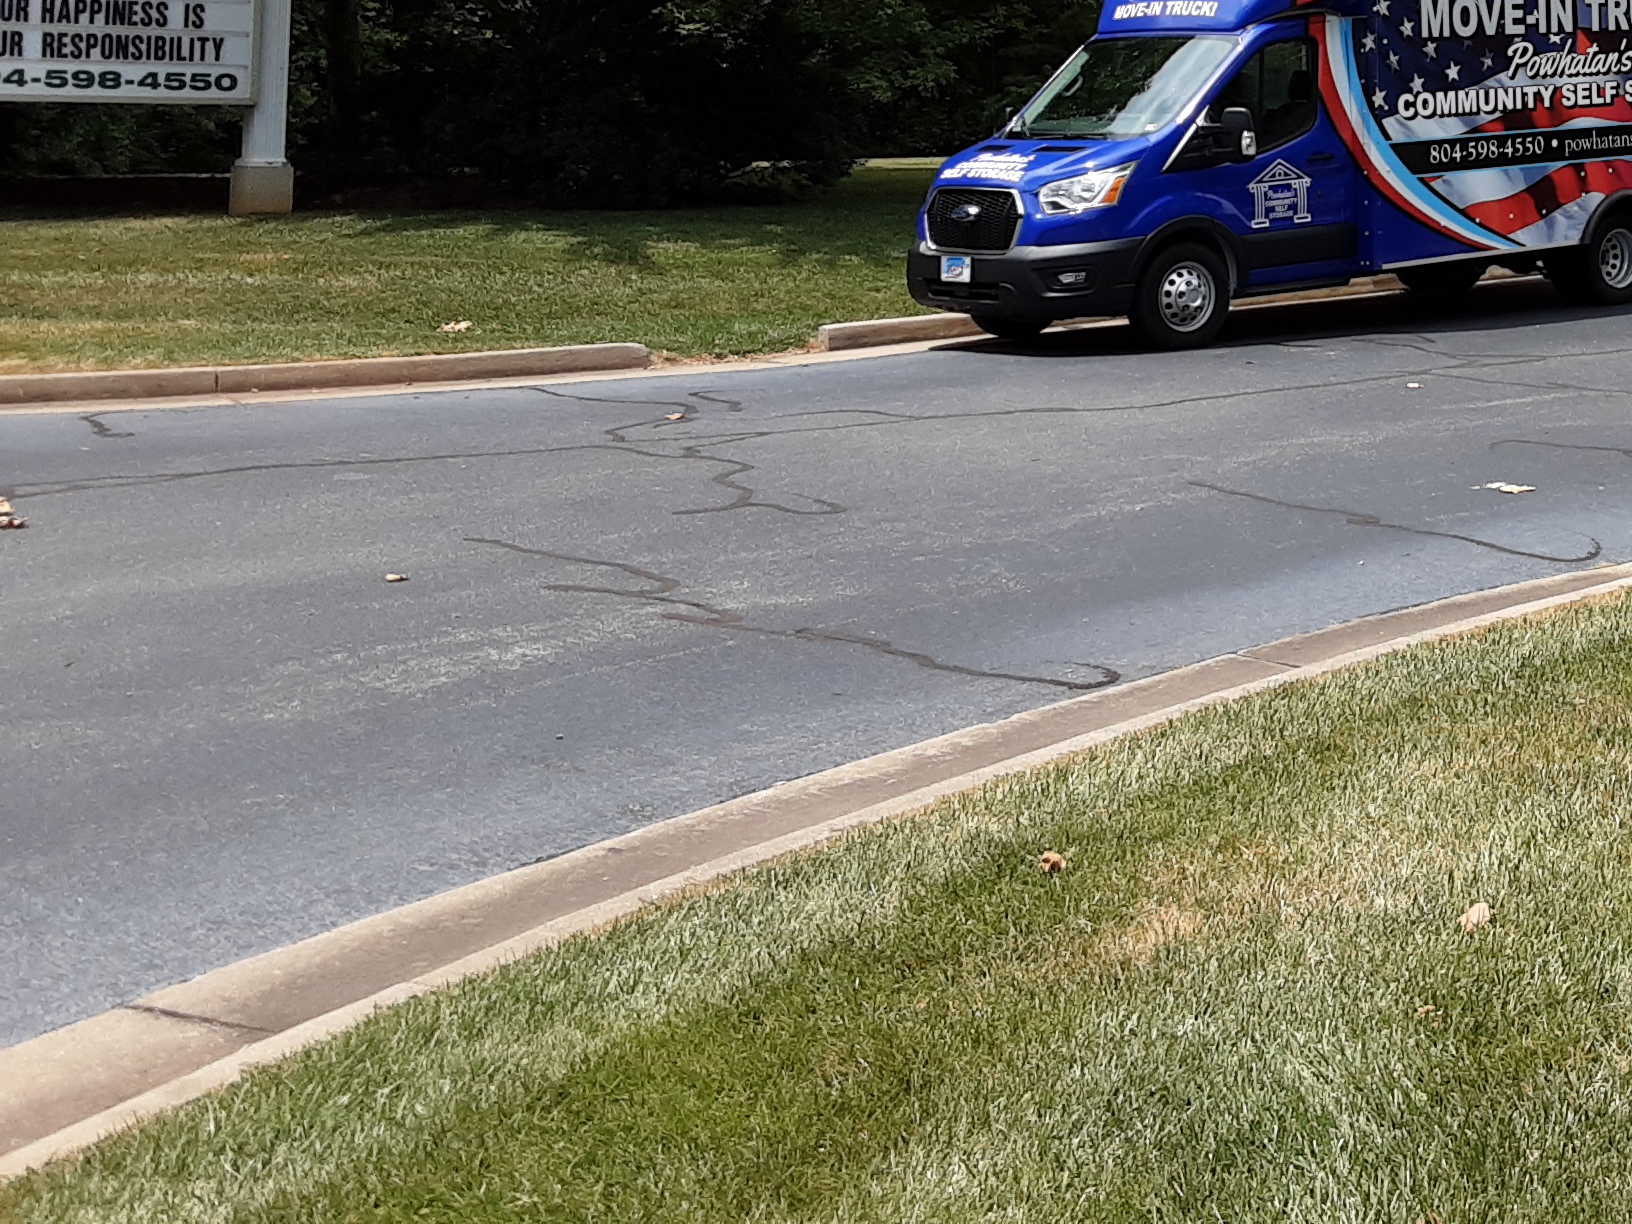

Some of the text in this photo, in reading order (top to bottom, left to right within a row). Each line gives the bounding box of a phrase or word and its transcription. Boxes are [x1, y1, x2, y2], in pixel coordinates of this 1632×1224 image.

[183, 3, 206, 29] IS
[1113, 0, 1219, 20] MOVE-IN TRUCK!
[42, 32, 224, 62] RESPONSIBILITY
[1398, 84, 1555, 118] COMMUNITY
[1561, 81, 1619, 107] SELF
[1429, 136, 1545, 164] 804-598-4550
